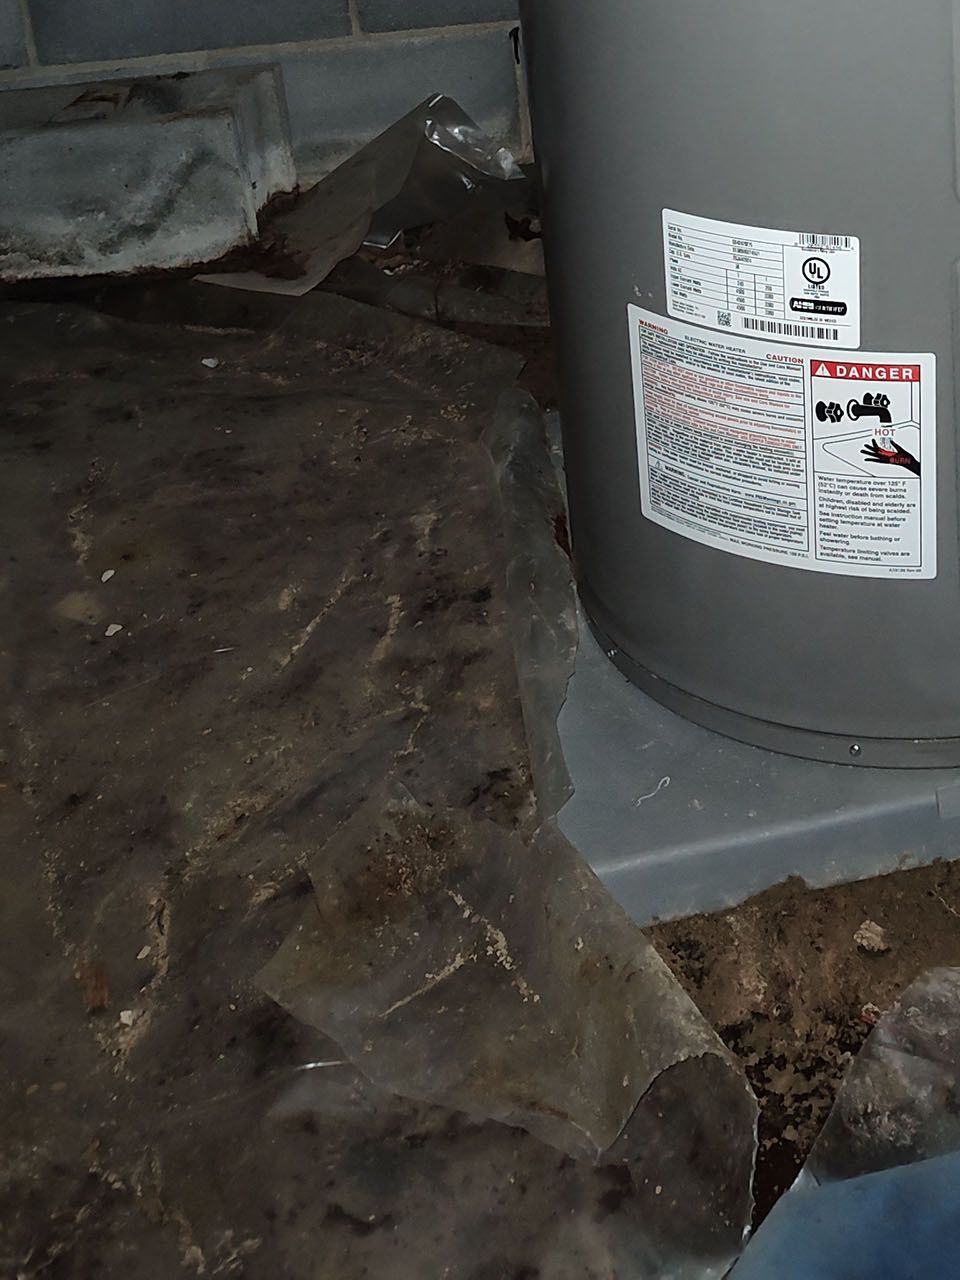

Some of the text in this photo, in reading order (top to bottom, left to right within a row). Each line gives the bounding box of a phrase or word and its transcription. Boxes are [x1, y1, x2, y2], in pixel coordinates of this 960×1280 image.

[809, 262, 823, 279] UL
[638, 319, 669, 334] WARNING
[766, 353, 804, 364] CAUTION
[836, 365, 913, 380] DANGER
[874, 428, 896, 436] HOT
[836, 478, 871, 486] temperature
[831, 512, 862, 520] instruction
[840, 519, 875, 527] temperature
[820, 545, 855, 553] Temperature
